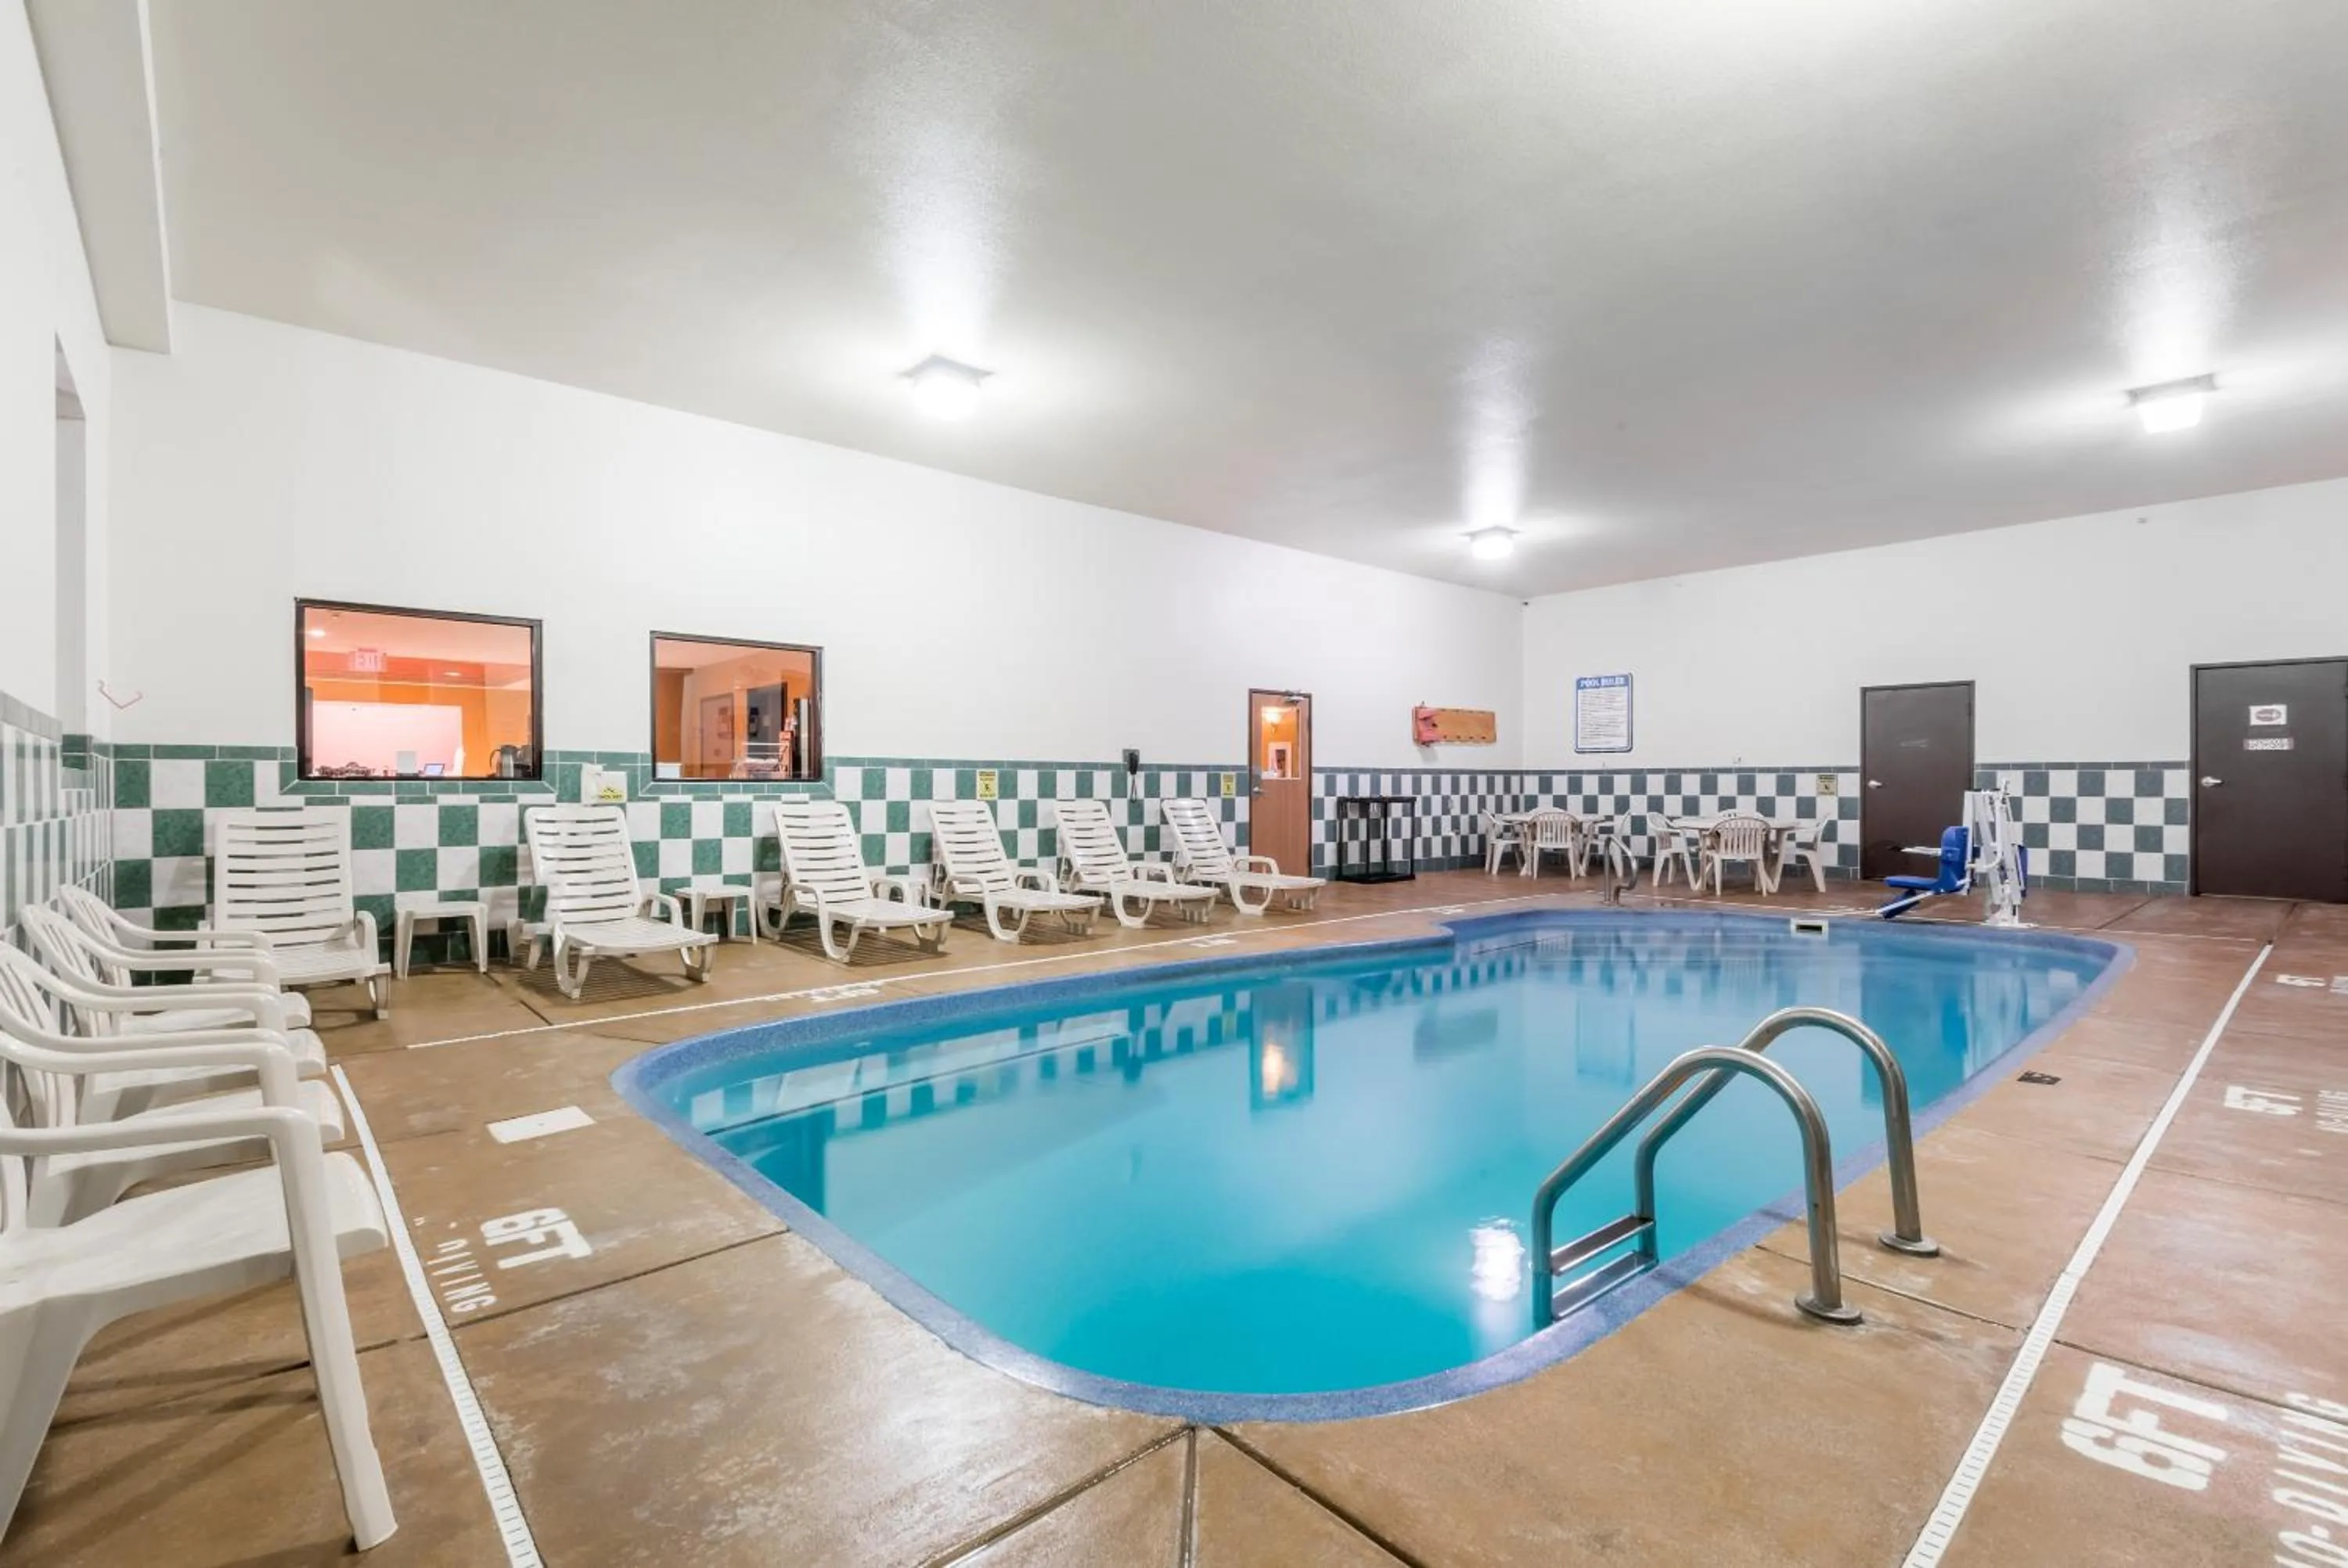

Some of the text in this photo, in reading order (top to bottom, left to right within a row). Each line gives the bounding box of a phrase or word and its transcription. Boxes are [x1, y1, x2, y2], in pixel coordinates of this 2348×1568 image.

[1580, 678, 1599, 689] POOL
[480, 1207, 592, 1269] 6FT
[2060, 1361, 2229, 1491] 6FT
